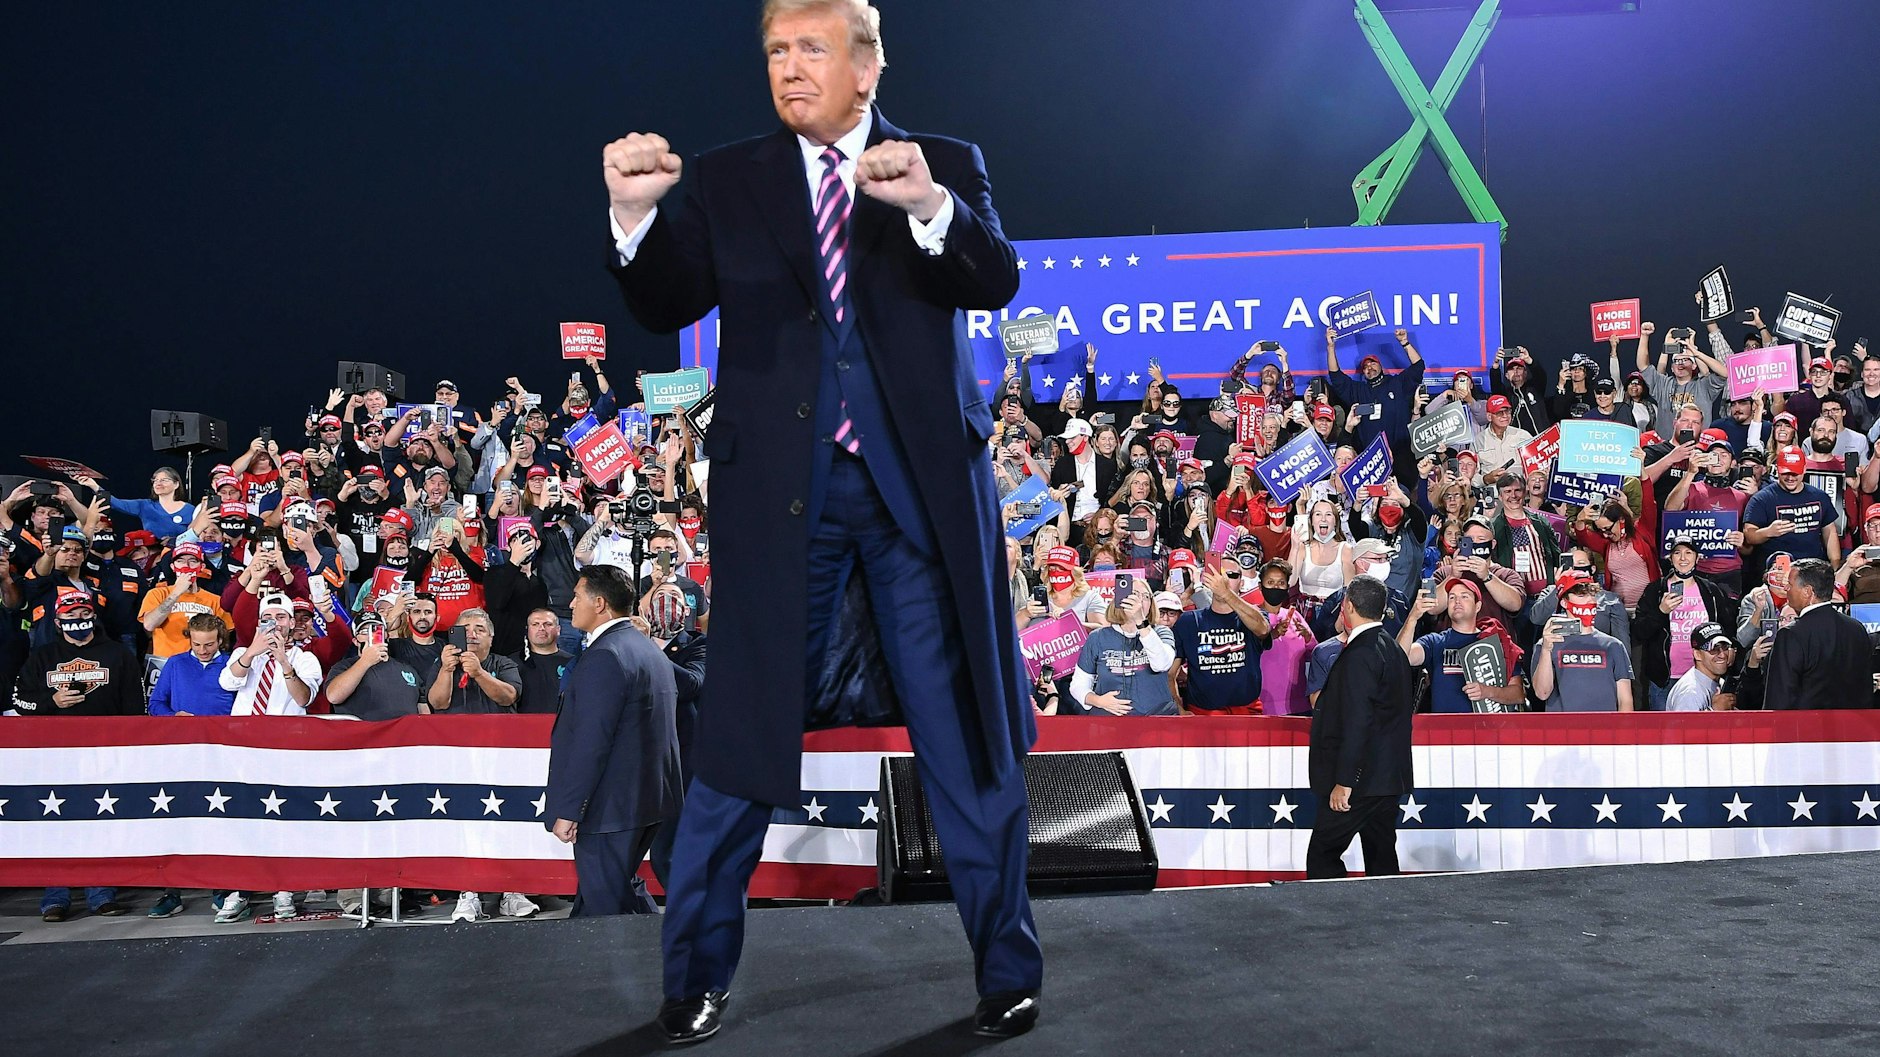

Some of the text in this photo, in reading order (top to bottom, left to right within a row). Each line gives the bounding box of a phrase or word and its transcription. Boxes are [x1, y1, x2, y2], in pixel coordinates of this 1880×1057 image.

[1334, 301, 1369, 320] 4 MORE
[1708, 294, 1720, 318] COPS
[1102, 299, 1261, 335] GREAT
[1335, 311, 1371, 330] YEARS!
[1596, 309, 1632, 321] 4 MORE
[1786, 306, 1815, 325] COPS
[1598, 320, 1631, 332] YEARS!
[1785, 319, 1828, 341] FOR TRUMP
[565, 336, 604, 345] AMERICA
[1010, 327, 1050, 342] VETERANS
[1734, 362, 1787, 380] Women
[1741, 373, 1783, 384] FOR TRUMP
[653, 382, 700, 395] Latinos
[675, 393, 699, 402] TRUMP
[1242, 401, 1248, 413] TO
[1248, 404, 1256, 439] SCOTUS
[1419, 415, 1460, 440] VETERANS
[1425, 425, 1457, 444] FOR TRUMP
[1587, 430, 1616, 441] TEXT
[585, 451, 593, 462] 4
[591, 434, 620, 458] MORE
[1581, 442, 1622, 453] VAMOS
[591, 446, 626, 473] YEARS!
[1271, 443, 1316, 480] 4 MORE
[1526, 454, 1544, 467] FILL
[1575, 454, 1628, 465] TO 88022
[1277, 455, 1322, 490] YEARS!
[1352, 448, 1383, 485] 4 MORE
[1362, 459, 1386, 487] EARS!
[1553, 475, 1618, 495] FILL THAT
[1685, 518, 1716, 527] MAKE
[1665, 528, 1731, 540] AMERICA
[1700, 541, 1734, 550] AGAIN
[431, 566, 468, 578] Trump
[427, 583, 470, 592] Pence 2020
[1092, 586, 1115, 595] MAK
[1572, 606, 1597, 616] MAG
[61, 620, 93, 631] MAGA
[1699, 624, 1722, 636] TRUMP
[1197, 631, 1245, 646] Trump
[1027, 630, 1082, 661] Women
[1040, 645, 1080, 666] FOR TRUMP
[1198, 654, 1225, 665] Pence
[1563, 653, 1602, 664] ae usa
[64, 663, 92, 671] MOTOR
[1106, 659, 1122, 667] 2020
[51, 671, 105, 683] HARLEY-DAVIDSON
